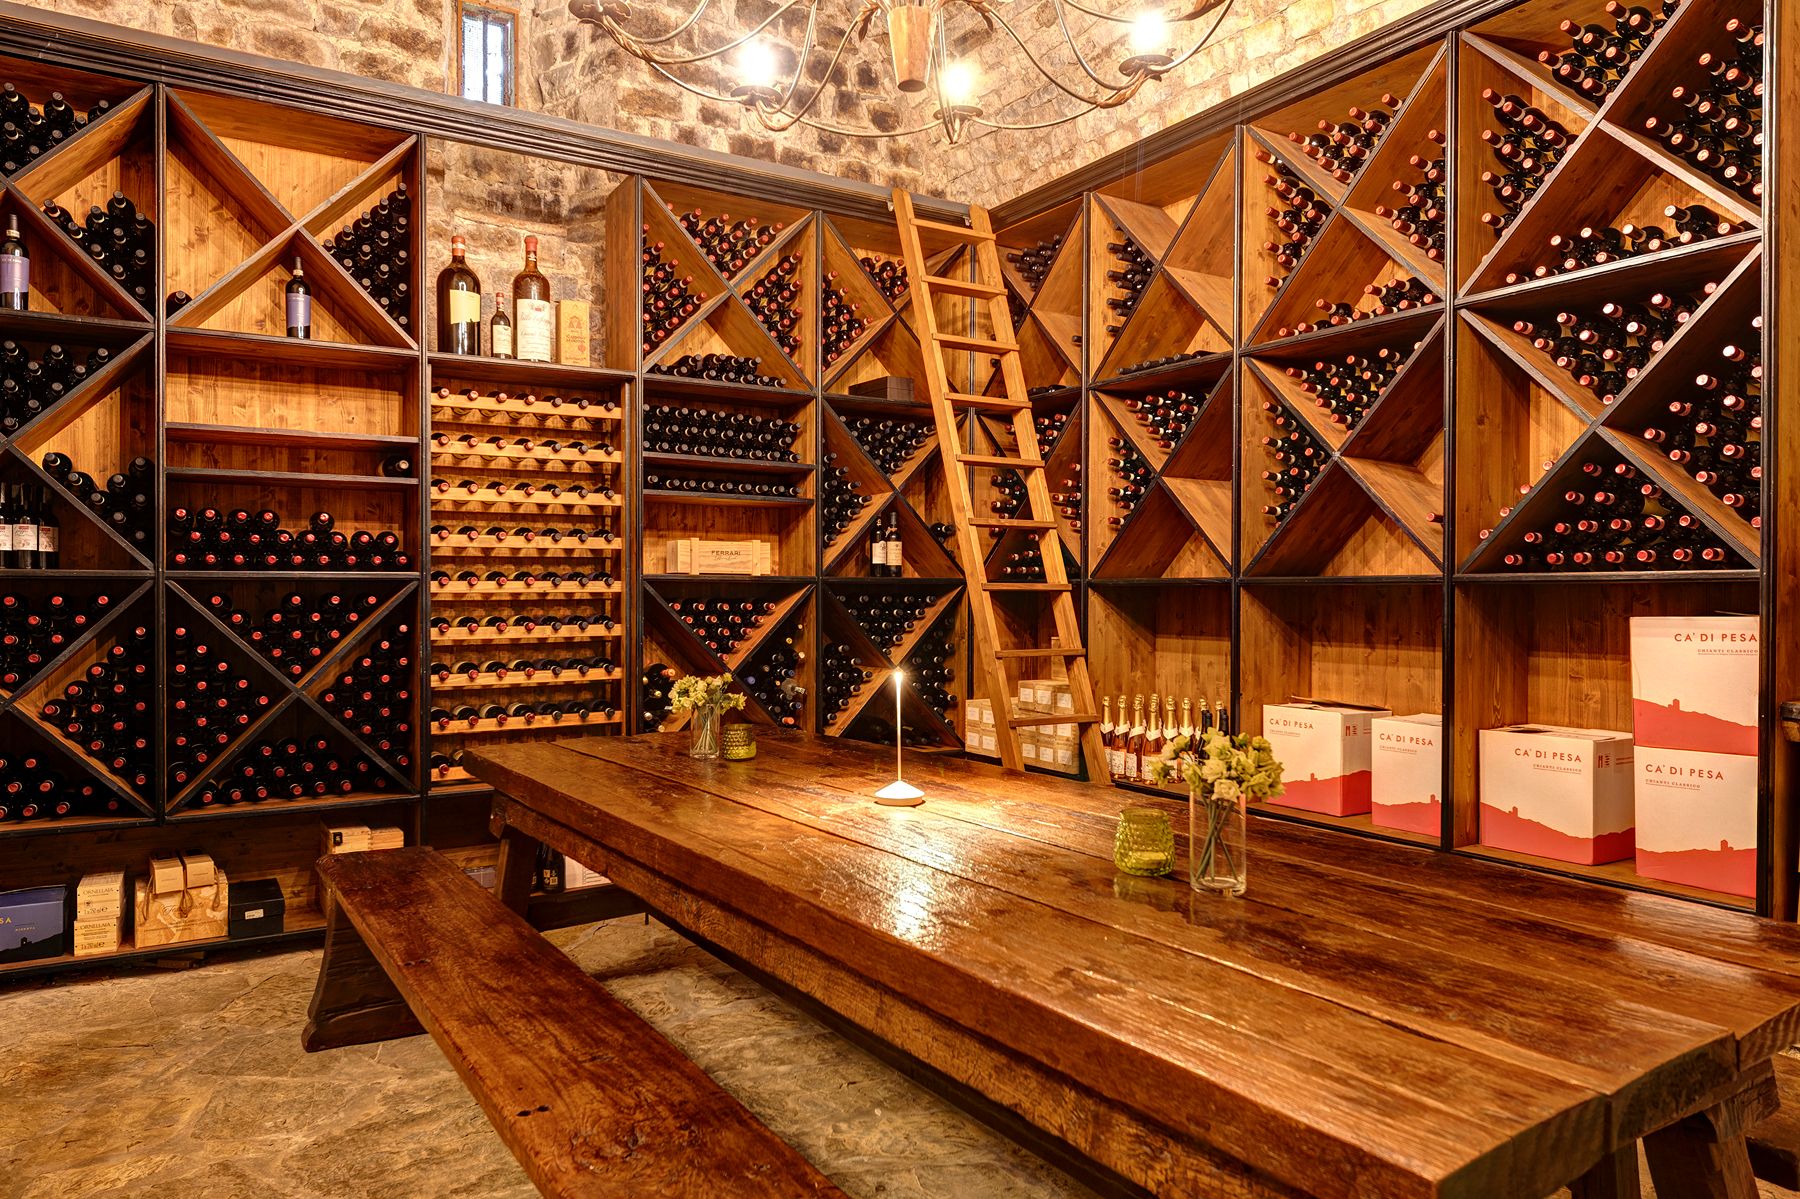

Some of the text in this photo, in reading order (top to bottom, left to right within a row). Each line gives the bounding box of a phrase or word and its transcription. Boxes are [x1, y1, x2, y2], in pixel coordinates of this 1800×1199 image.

[1700, 633, 1714, 642] DI
[1721, 633, 1758, 642] PESA
[1283, 719, 1291, 727] DI
[1294, 720, 1314, 730] PESA
[1396, 735, 1406, 743] DI
[1409, 736, 1434, 747] PESA
[1535, 750, 1547, 759] DI
[1552, 752, 1582, 763] PESA
[1669, 766, 1683, 776] DI
[1689, 768, 1724, 781] PESA
